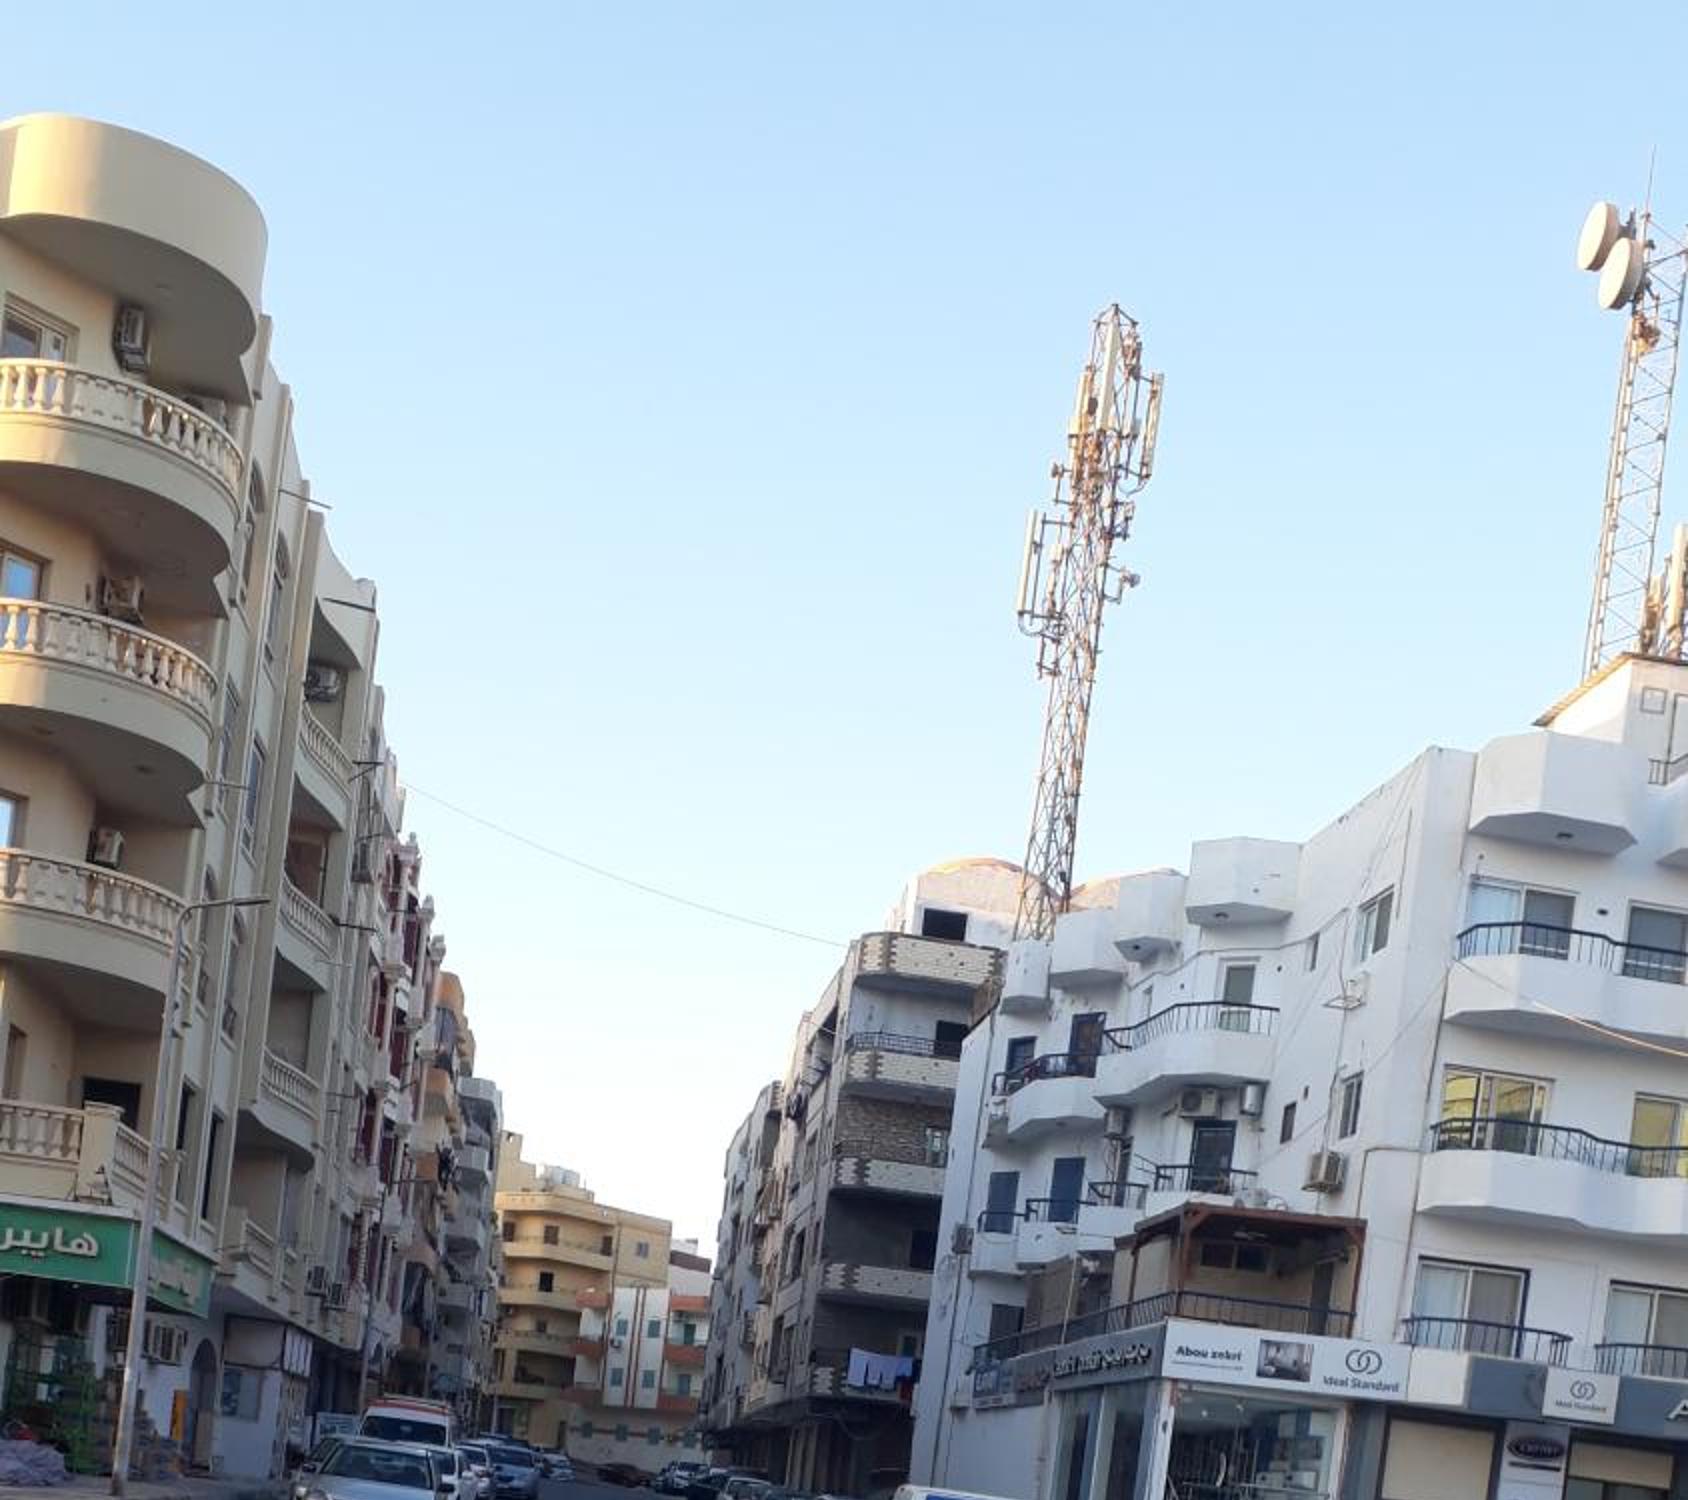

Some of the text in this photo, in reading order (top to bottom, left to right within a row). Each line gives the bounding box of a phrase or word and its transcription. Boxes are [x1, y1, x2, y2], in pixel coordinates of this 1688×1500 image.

[1175, 1344, 1209, 1359] Abou
[1323, 1375, 1399, 1393] Ideal Standard
